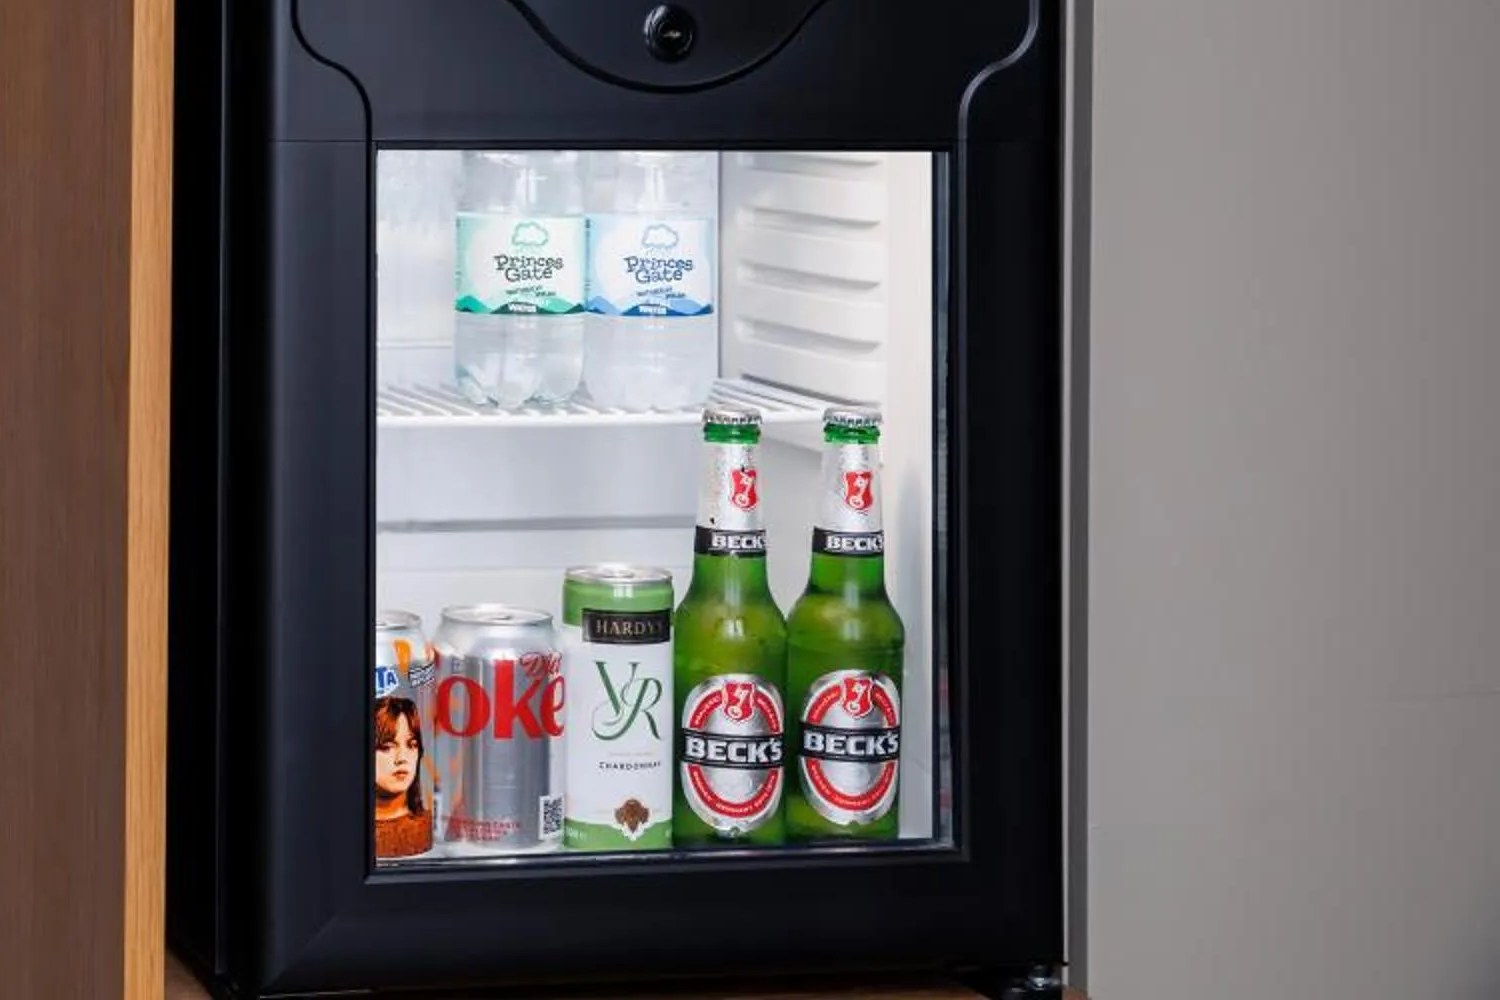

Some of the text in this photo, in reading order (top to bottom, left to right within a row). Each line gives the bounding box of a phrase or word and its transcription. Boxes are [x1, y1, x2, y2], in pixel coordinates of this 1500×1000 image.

[493, 254, 564, 270] Princes
[623, 256, 693, 272] Princes
[505, 267, 553, 282] Gate
[636, 269, 683, 284] Gate
[685, 735, 783, 763] BECK'S
[804, 731, 898, 755] BECK'S
